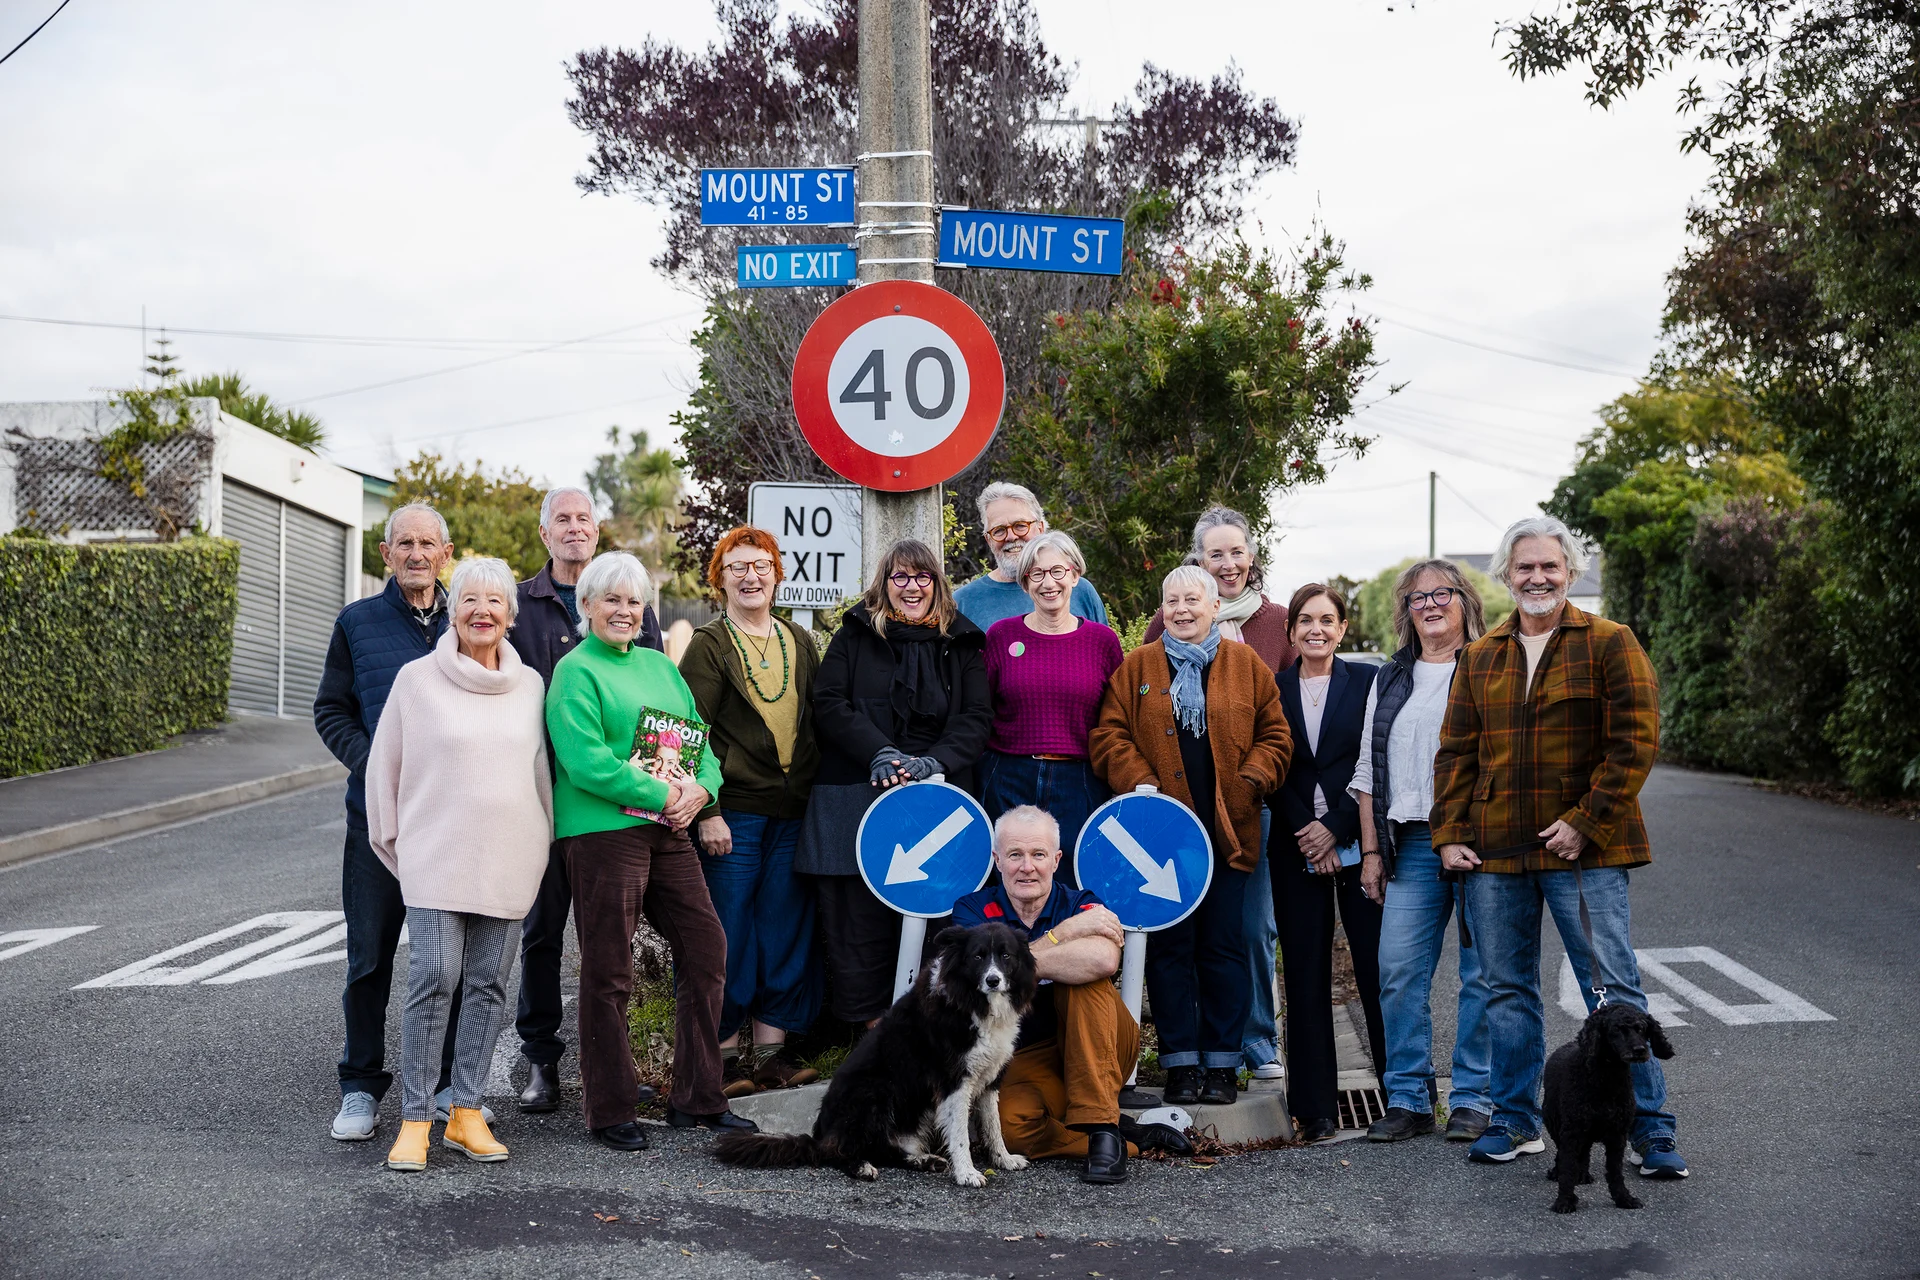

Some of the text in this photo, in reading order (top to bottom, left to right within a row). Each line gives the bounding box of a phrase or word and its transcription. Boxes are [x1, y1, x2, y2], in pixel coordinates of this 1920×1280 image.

[707, 172, 848, 203] MOUNT ST
[747, 205, 766, 221] 41
[785, 205, 808, 221] 85
[954, 221, 1110, 264] MOUNT ST
[745, 251, 842, 280] NO EXIT
[839, 346, 956, 421] 40
[783, 506, 833, 538] NO
[779, 551, 845, 582] XIT
[806, 587, 843, 603] DOWN
